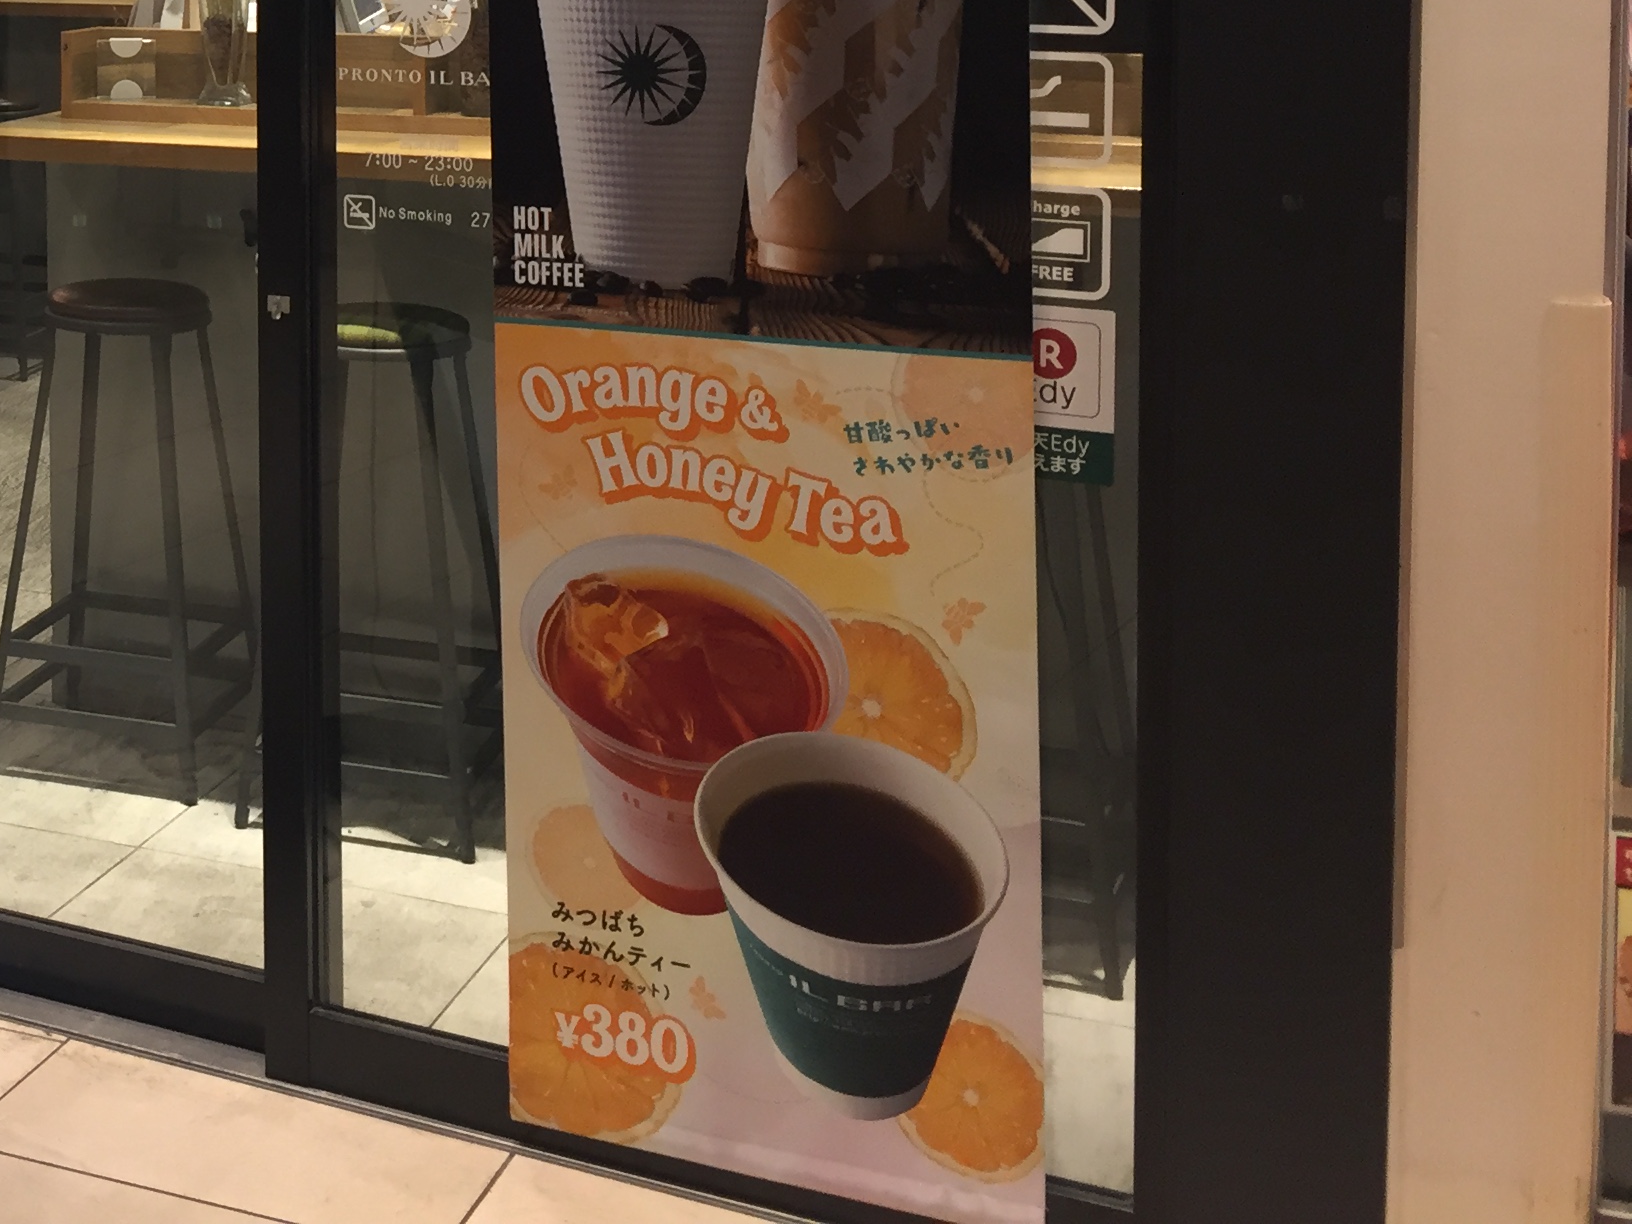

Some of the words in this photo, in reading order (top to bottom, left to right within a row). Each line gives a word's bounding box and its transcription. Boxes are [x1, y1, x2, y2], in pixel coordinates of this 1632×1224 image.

[337, 67, 422, 84] PRONTO
[430, 70, 454, 86] IL
[460, 71, 491, 87] BA
[365, 153, 402, 169] 7:00
[424, 155, 473, 173] 23:00
[459, 176, 491, 189] 30分
[379, 206, 395, 220] No
[398, 207, 452, 225] Smoking
[471, 212, 490, 228] 27
[513, 206, 552, 232] HOT
[1033, 200, 1081, 217] harge
[513, 233, 565, 260] MILK
[513, 260, 585, 288] COFFEE
[1039, 338, 1064, 369] R
[521, 363, 729, 431] Orange
[740, 387, 779, 431] &
[1033, 379, 1077, 409] dy
[843, 418, 961, 446] 甘酸っぱい
[1034, 432, 1090, 458] 天Edy
[853, 445, 1014, 477] さわやかな香り
[1034, 454, 1087, 475] えます
[586, 431, 770, 531] Honey
[786, 471, 898, 546] Tea
[551, 901, 646, 938] みつばち
[551, 931, 692, 973] みかんティー
[554, 1003, 689, 1074] ¥380
